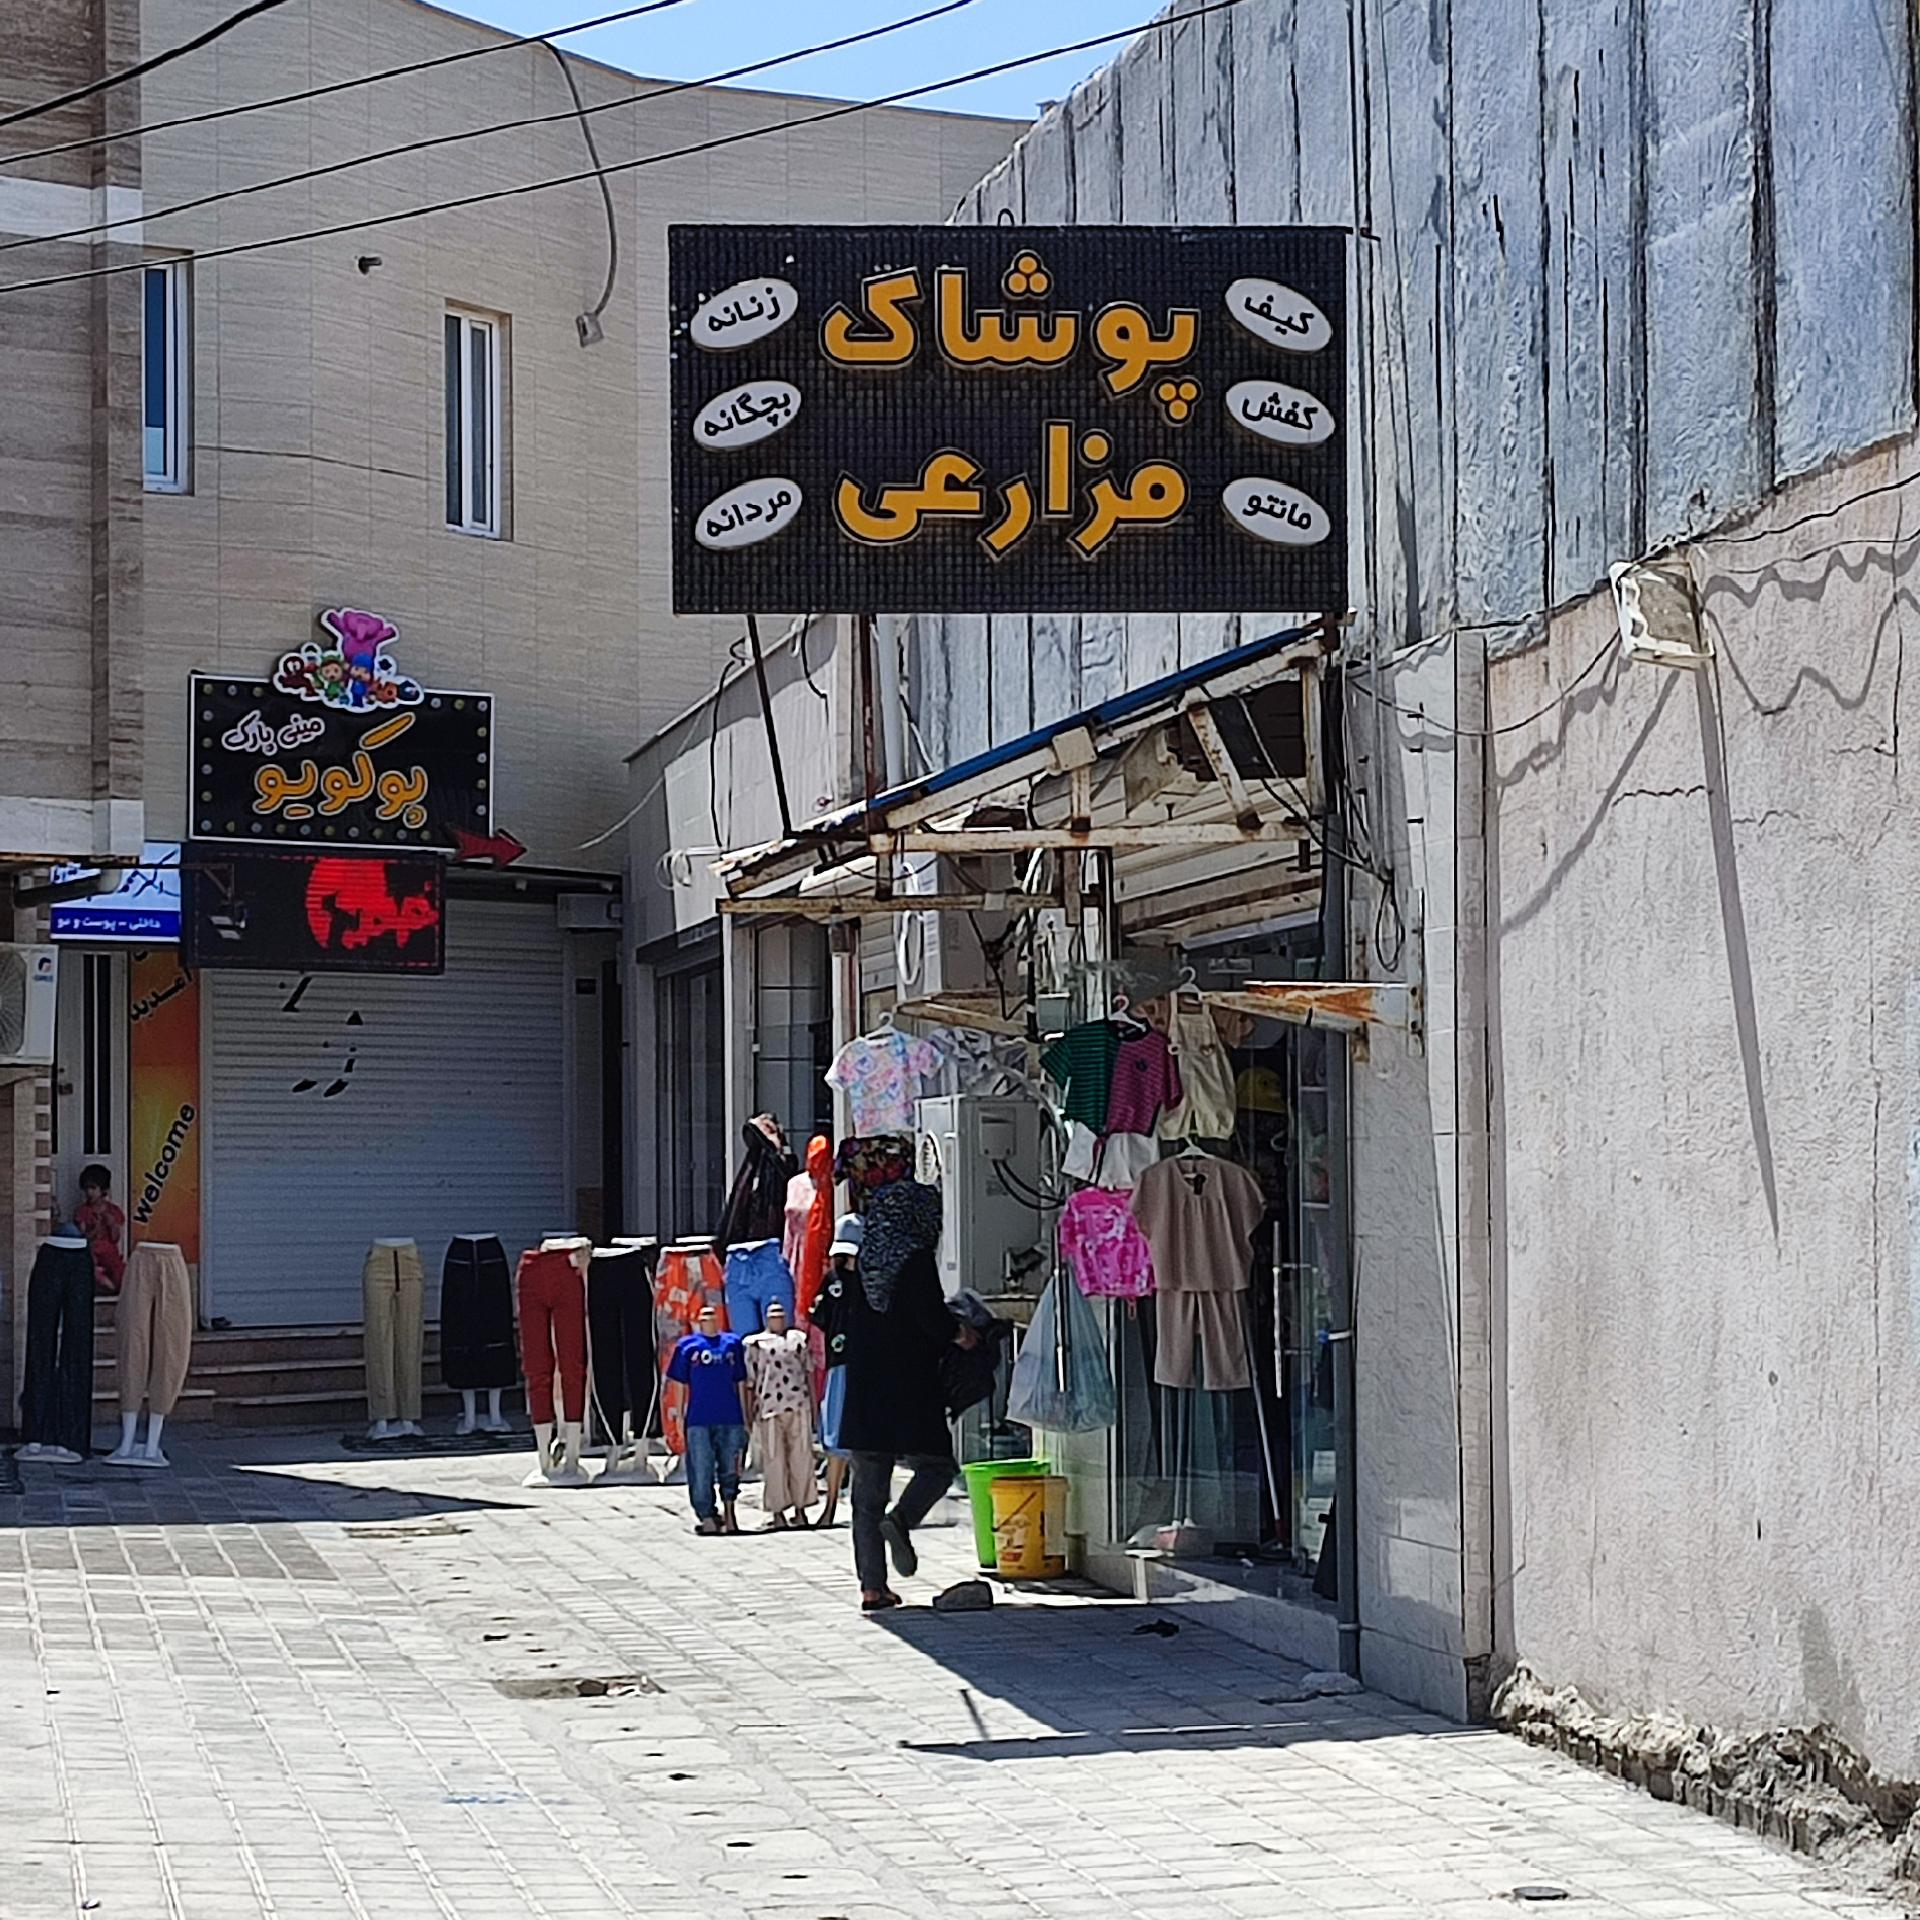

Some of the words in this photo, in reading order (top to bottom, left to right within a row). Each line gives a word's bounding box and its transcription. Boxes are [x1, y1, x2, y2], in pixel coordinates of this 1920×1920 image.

[708, 287, 781, 332] زنانه
[1245, 294, 1315, 335] کیف
[819, 250, 1202, 426] پوشاک
[704, 392, 791, 437] بچگانه
[1242, 392, 1319, 431] کفش
[833, 419, 1191, 561] مزارعی
[1242, 494, 1312, 530] مانتو
[706, 490, 792, 537] مردانه
[277, 714, 325, 749] مینی
[134, 1103, 195, 1224] welcome
